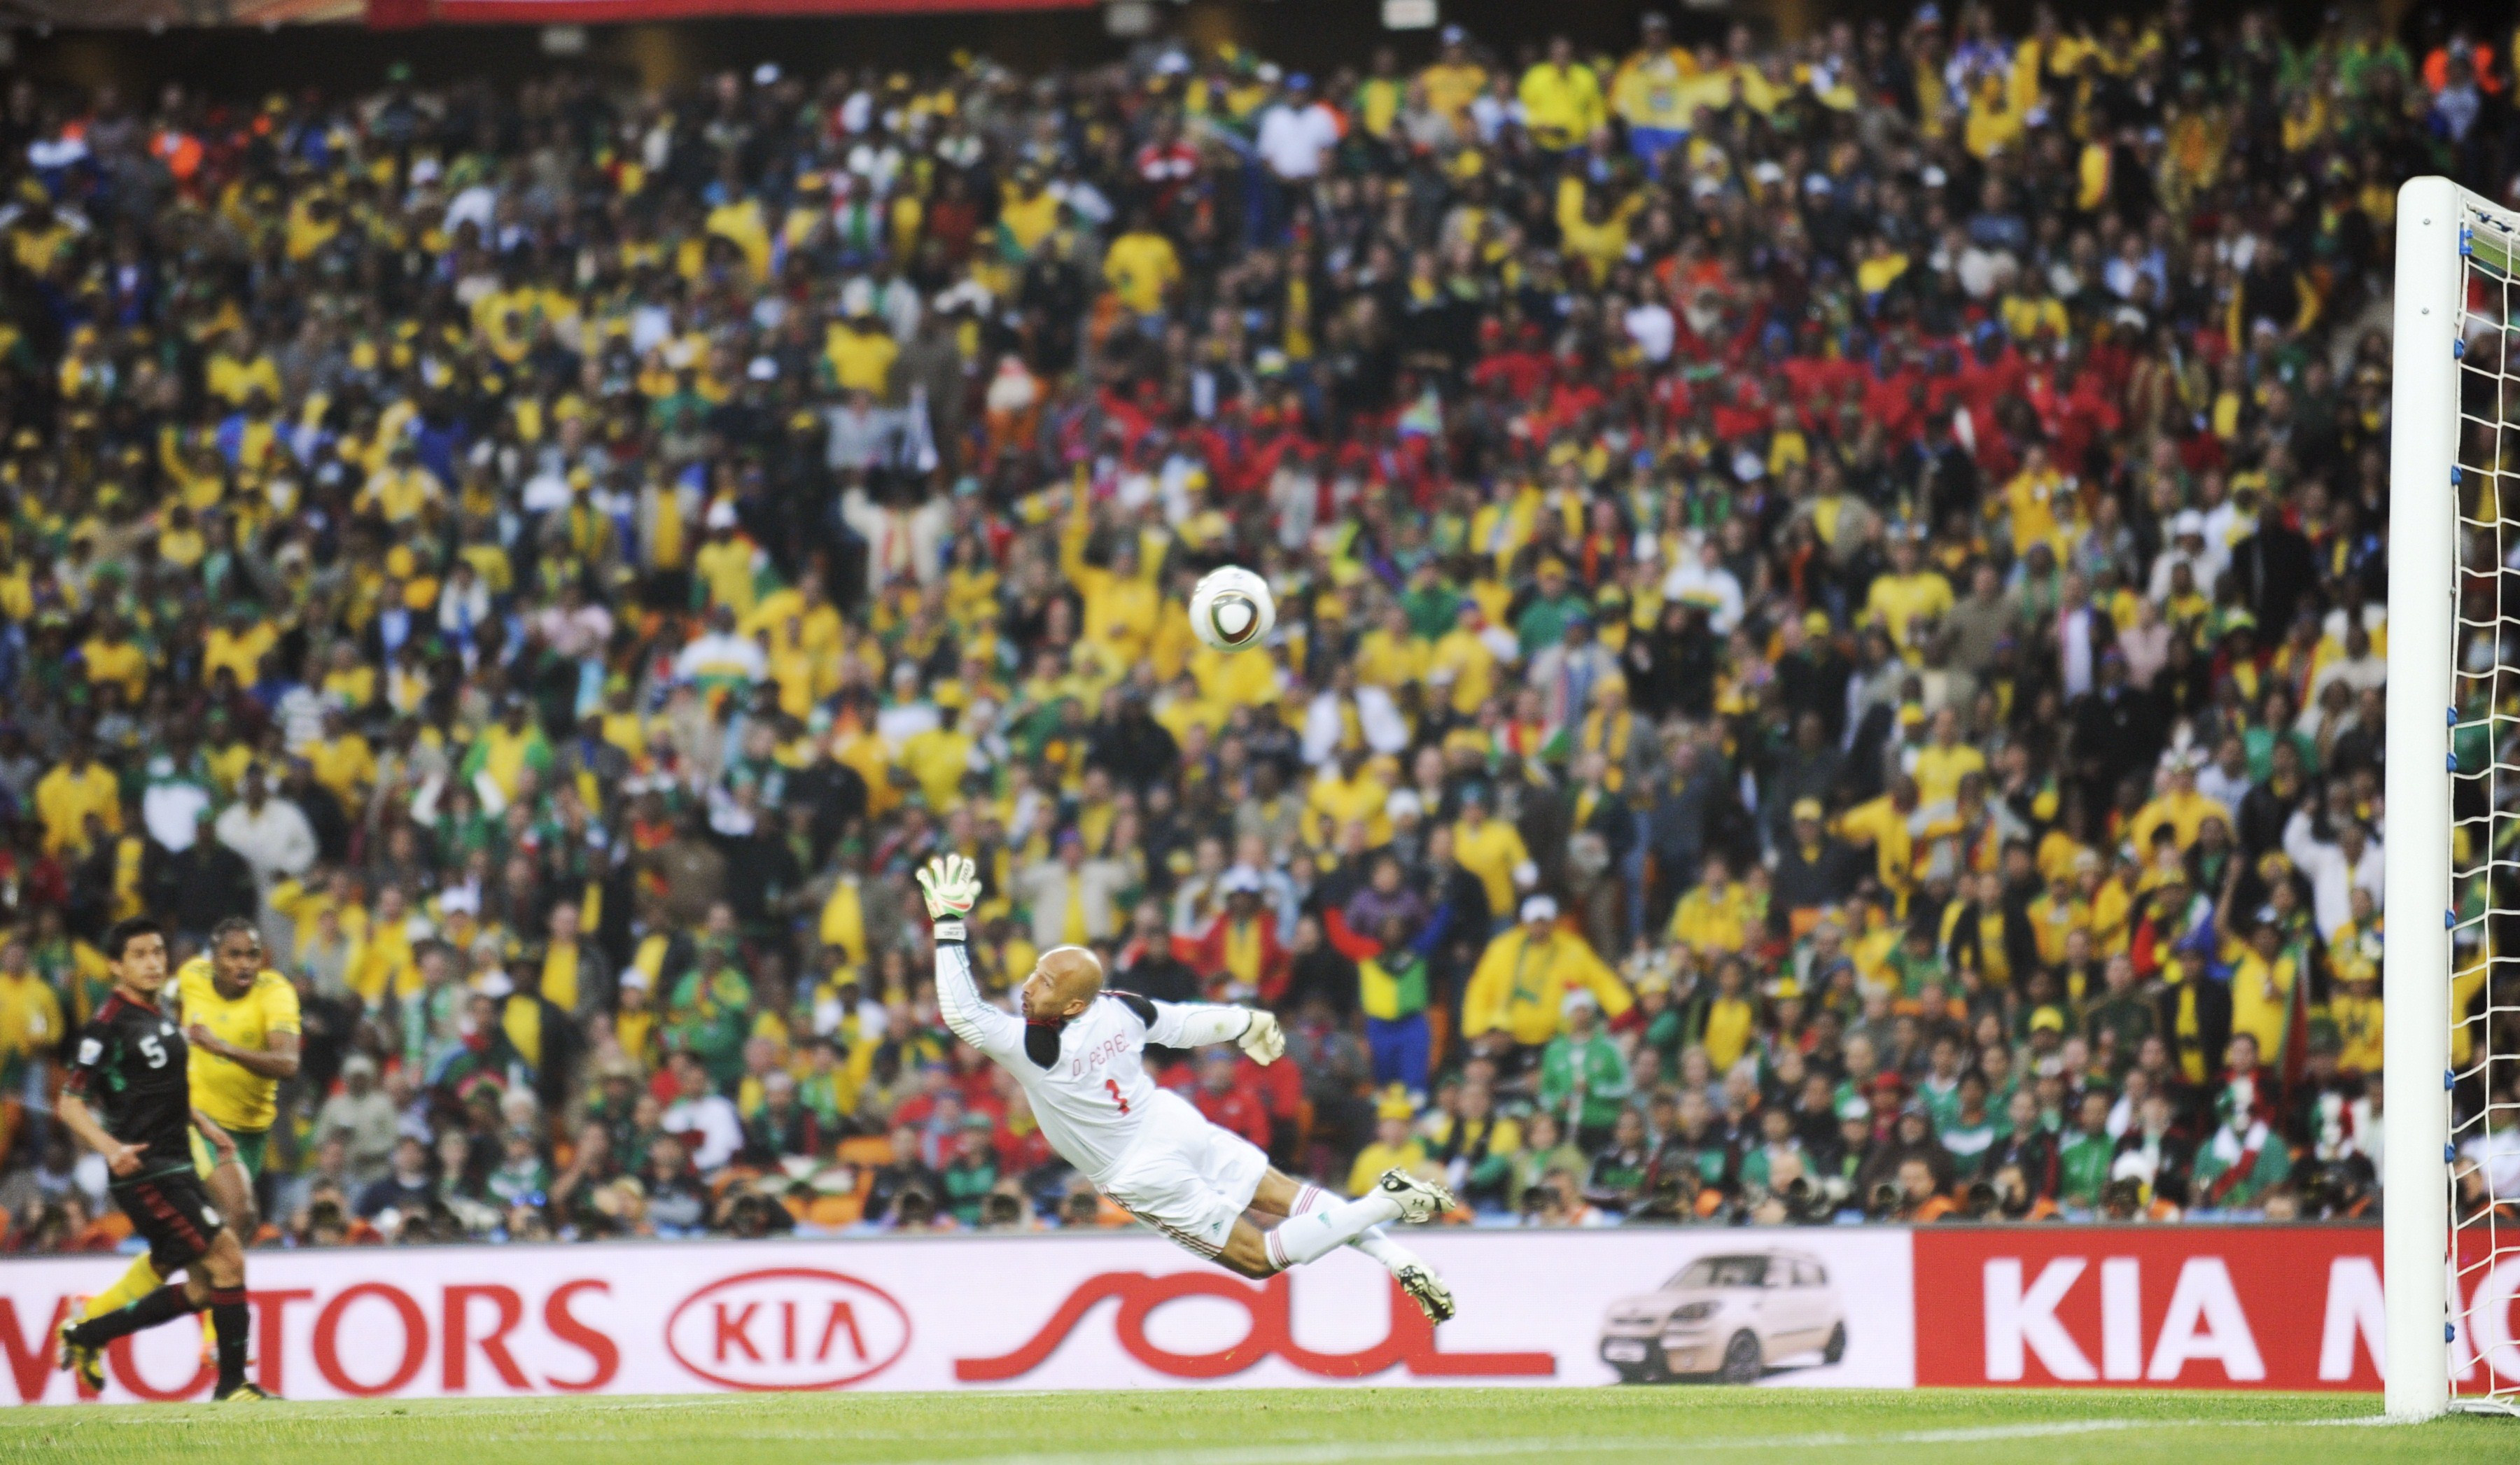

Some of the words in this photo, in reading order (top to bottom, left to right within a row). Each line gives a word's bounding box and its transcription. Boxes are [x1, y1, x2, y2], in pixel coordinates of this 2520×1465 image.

[139, 1035, 168, 1069] 5
[713, 1301, 869, 1362] KIA
[1982, 1256, 2267, 1382] KIA
